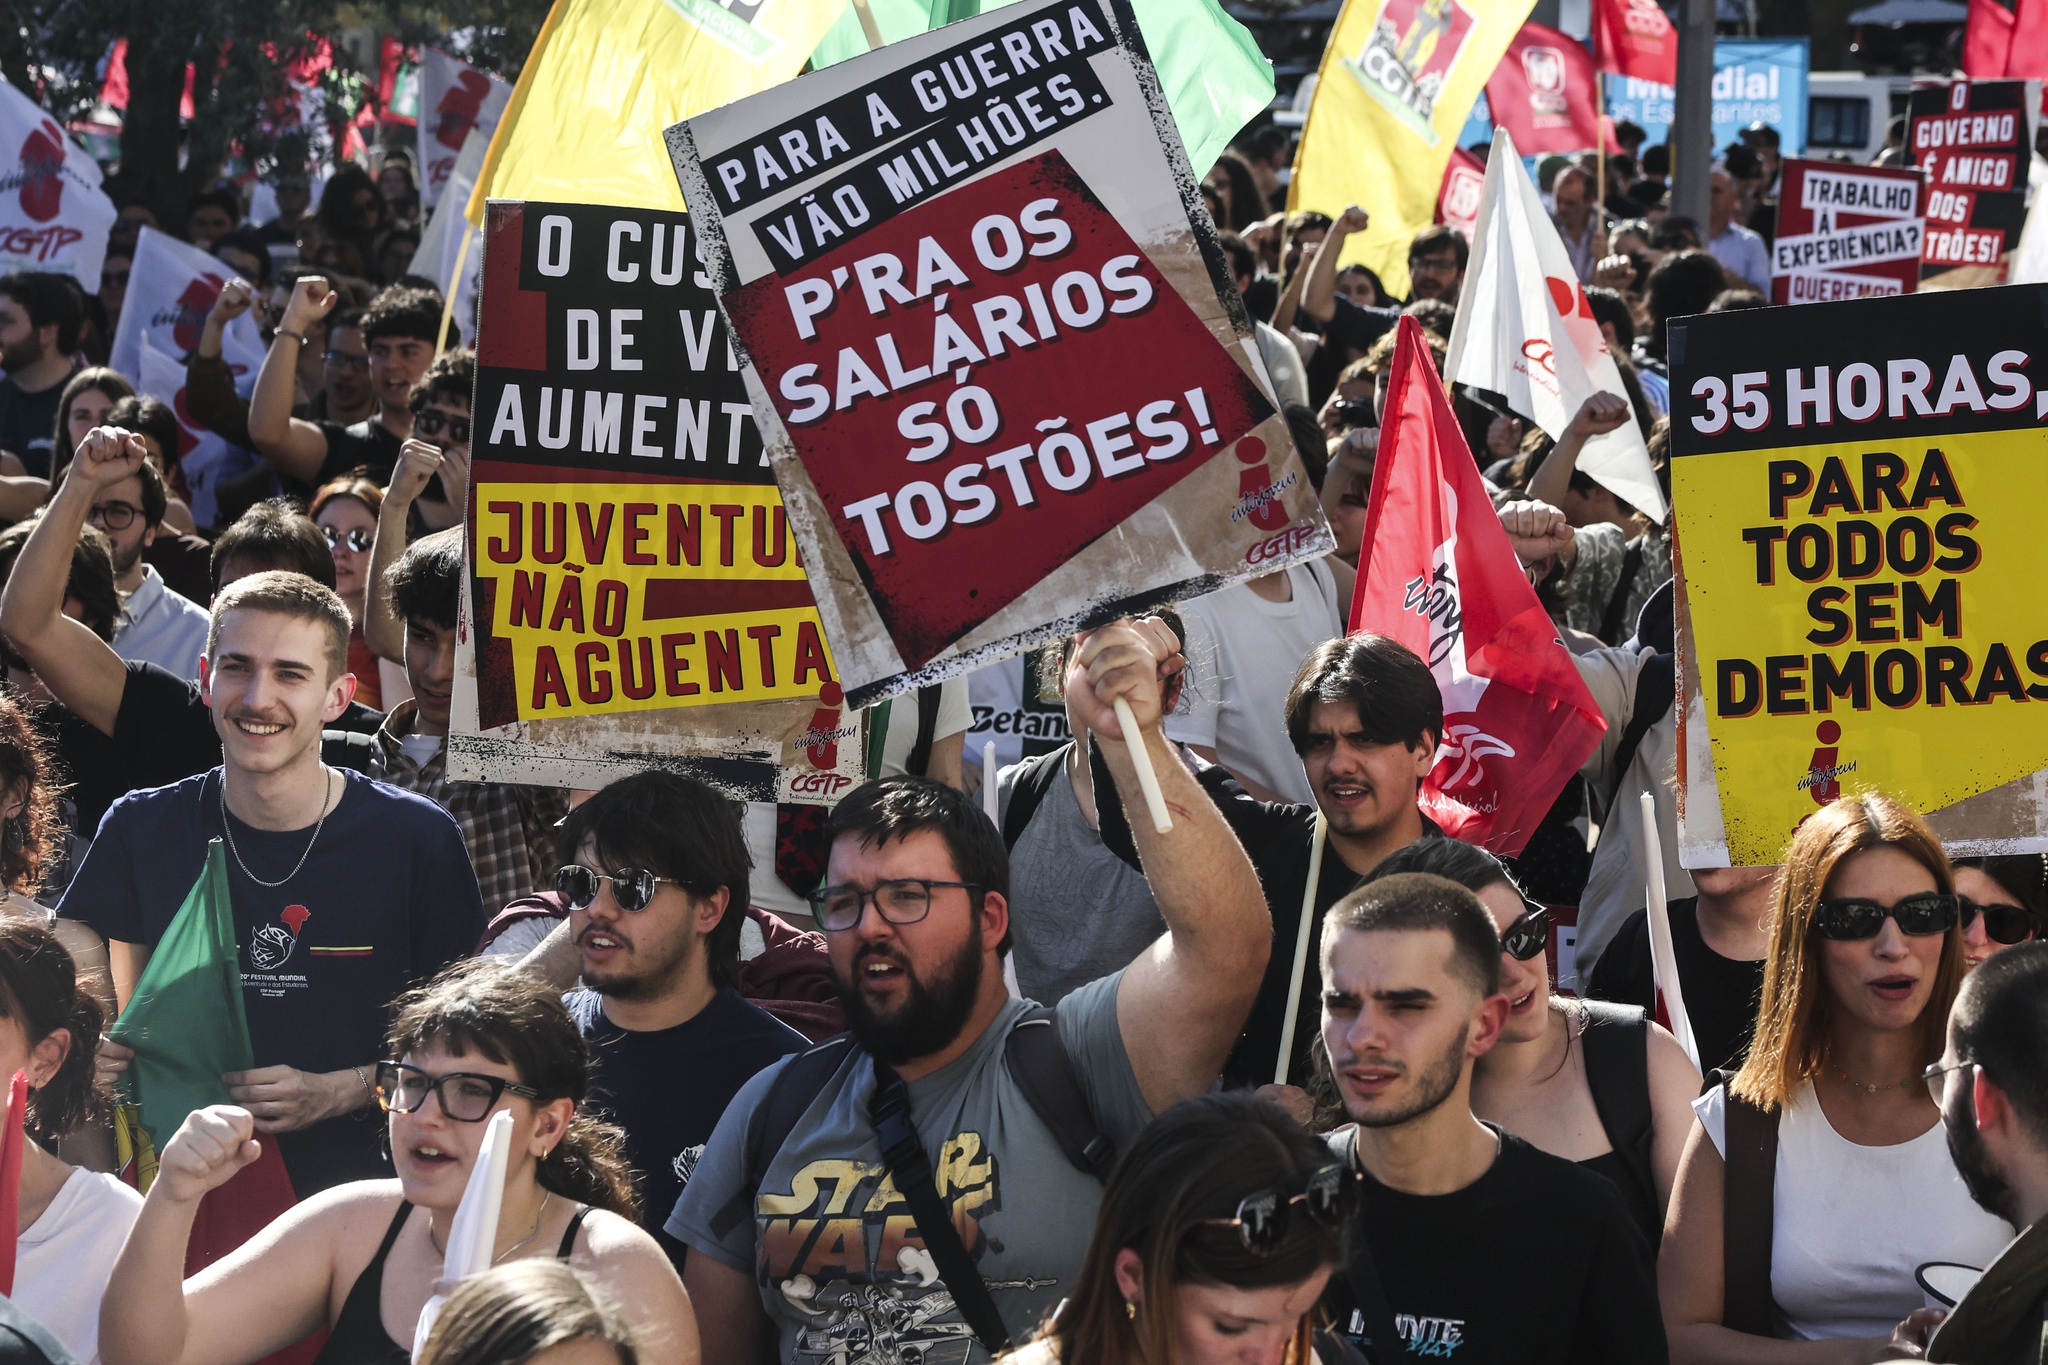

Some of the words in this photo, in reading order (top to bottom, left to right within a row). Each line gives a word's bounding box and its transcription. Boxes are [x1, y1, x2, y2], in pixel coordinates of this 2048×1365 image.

[716, 115, 851, 204] PARA
[868, 92, 902, 138] A
[910, 4, 1105, 115] GUERRA
[1916, 114, 2014, 149] GOVERNO
[1952, 83, 1967, 110] O
[766, 184, 872, 262] VÃO
[876, 72, 1104, 205] MILHÕES.
[1808, 178, 1911, 211] TRABALHO
[1922, 151, 1937, 184] É
[1942, 156, 2009, 187] AMIGO
[969, 197, 1075, 271] OS
[1927, 190, 1968, 223] DOS
[537, 214, 571, 277] O
[566, 308, 643, 372] DE
[778, 253, 1155, 425] SALÁRIOS
[488, 383, 770, 468] AUMENT
[896, 364, 1000, 464] SÓ
[1690, 372, 1770, 434] 35
[1786, 349, 2048, 424] HORAS,
[844, 386, 1221, 557] TOSTÕES!
[1768, 448, 1964, 519] PARA
[487, 500, 804, 569] JUVENTU
[1246, 525, 1315, 565] CGTP
[1742, 513, 1982, 586] TODOS
[510, 562, 629, 638] NÃO
[1805, 578, 1963, 647] SEM
[531, 620, 834, 710] AGUENTA
[791, 773, 852, 795] CGTP
